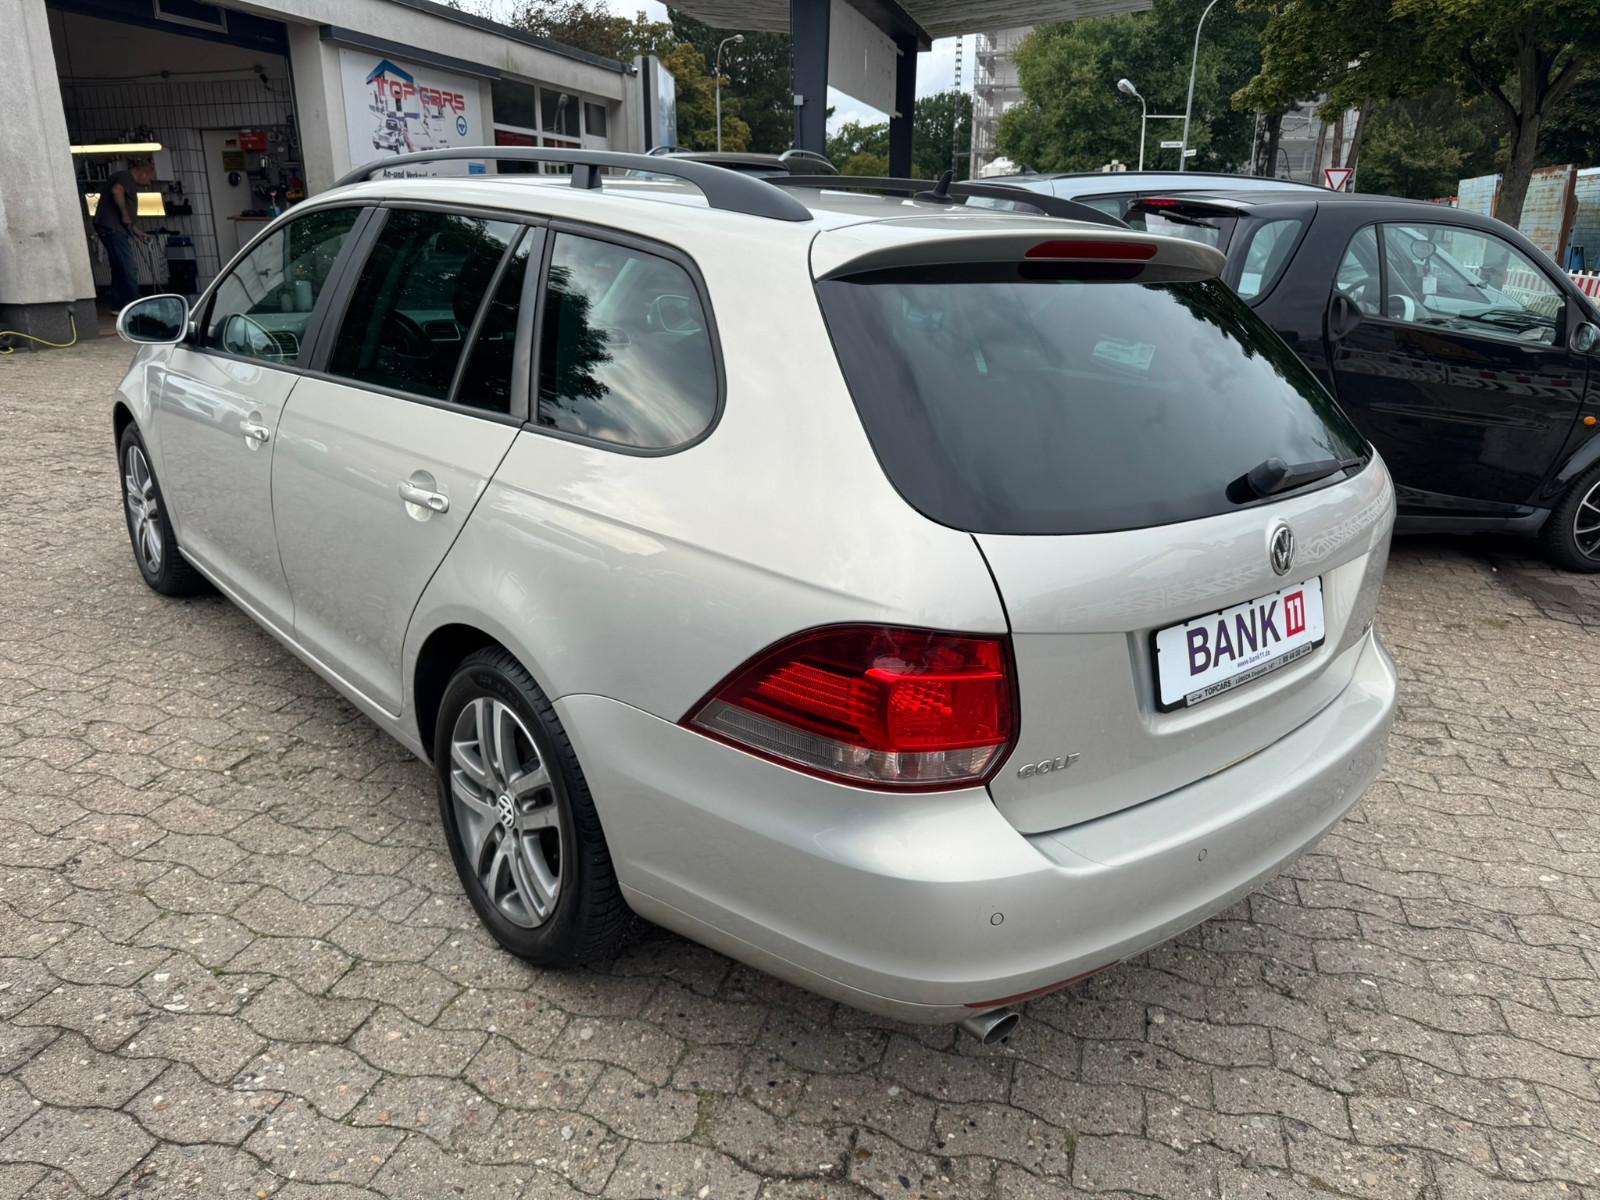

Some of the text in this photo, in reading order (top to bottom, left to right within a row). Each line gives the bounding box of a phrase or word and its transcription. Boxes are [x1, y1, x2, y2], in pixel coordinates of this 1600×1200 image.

[373, 77, 416, 101] TOP
[1186, 597, 1303, 677] BANK 11
[1204, 679, 1232, 696] TOPCARS
[1017, 752, 1081, 779] GOLF
